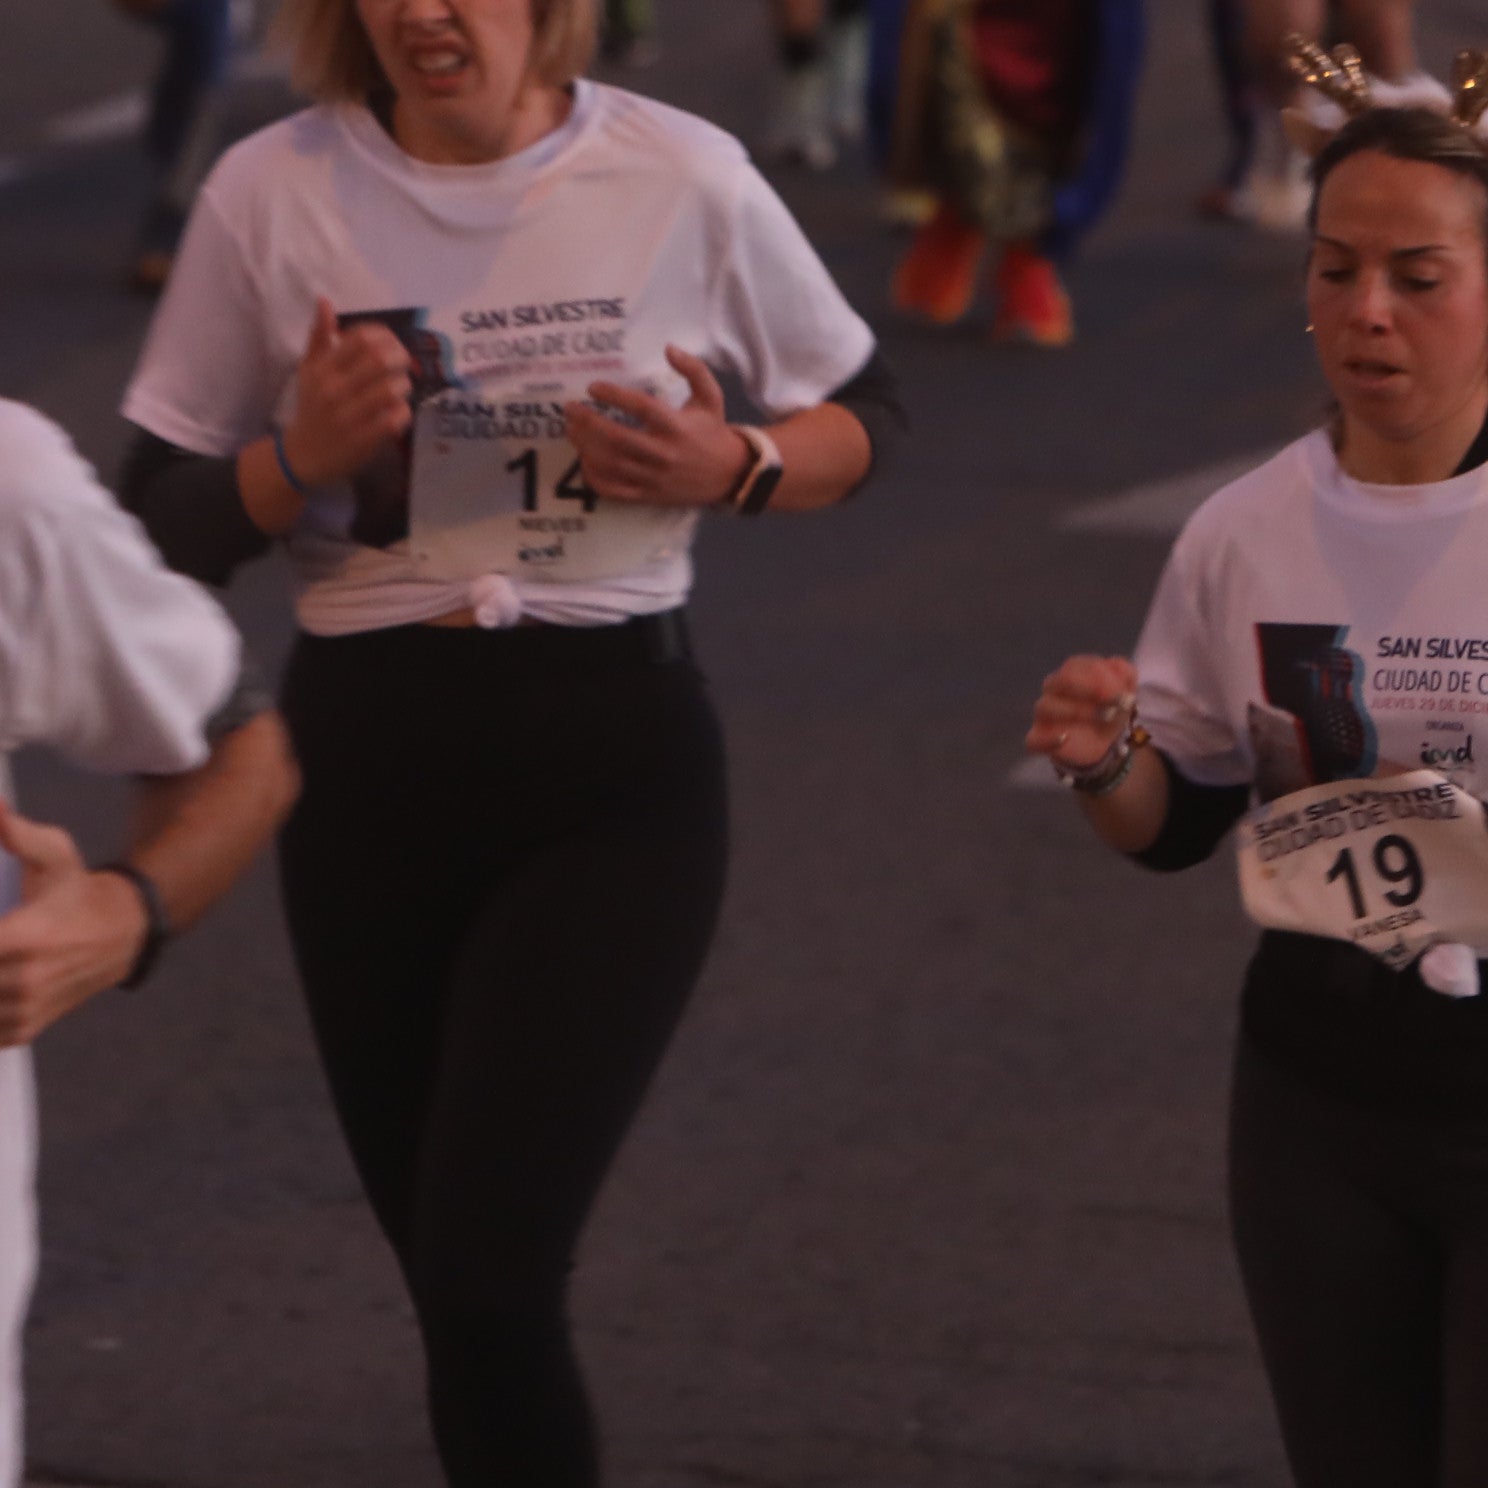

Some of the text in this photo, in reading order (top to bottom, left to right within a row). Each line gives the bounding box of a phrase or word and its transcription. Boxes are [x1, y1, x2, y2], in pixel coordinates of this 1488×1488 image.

[460, 296, 626, 333] SAN SILVESTRE
[462, 334, 538, 362] CIUDAD
[541, 332, 567, 356] DE
[436, 398, 496, 418] SAN
[505, 447, 598, 513] 14
[1377, 637, 1422, 659] SAN
[1373, 669, 1443, 692] CIUDAD
[1447, 670, 1473, 694] DE
[1371, 697, 1416, 710] JUEVES
[1419, 698, 1435, 711] 29
[1439, 698, 1456, 712] DE
[1253, 782, 1455, 841] SAN SILVESTRE
[1257, 817, 1347, 862] CIUDAD
[1349, 803, 1388, 832] DE
[1325, 833, 1426, 920] 19
